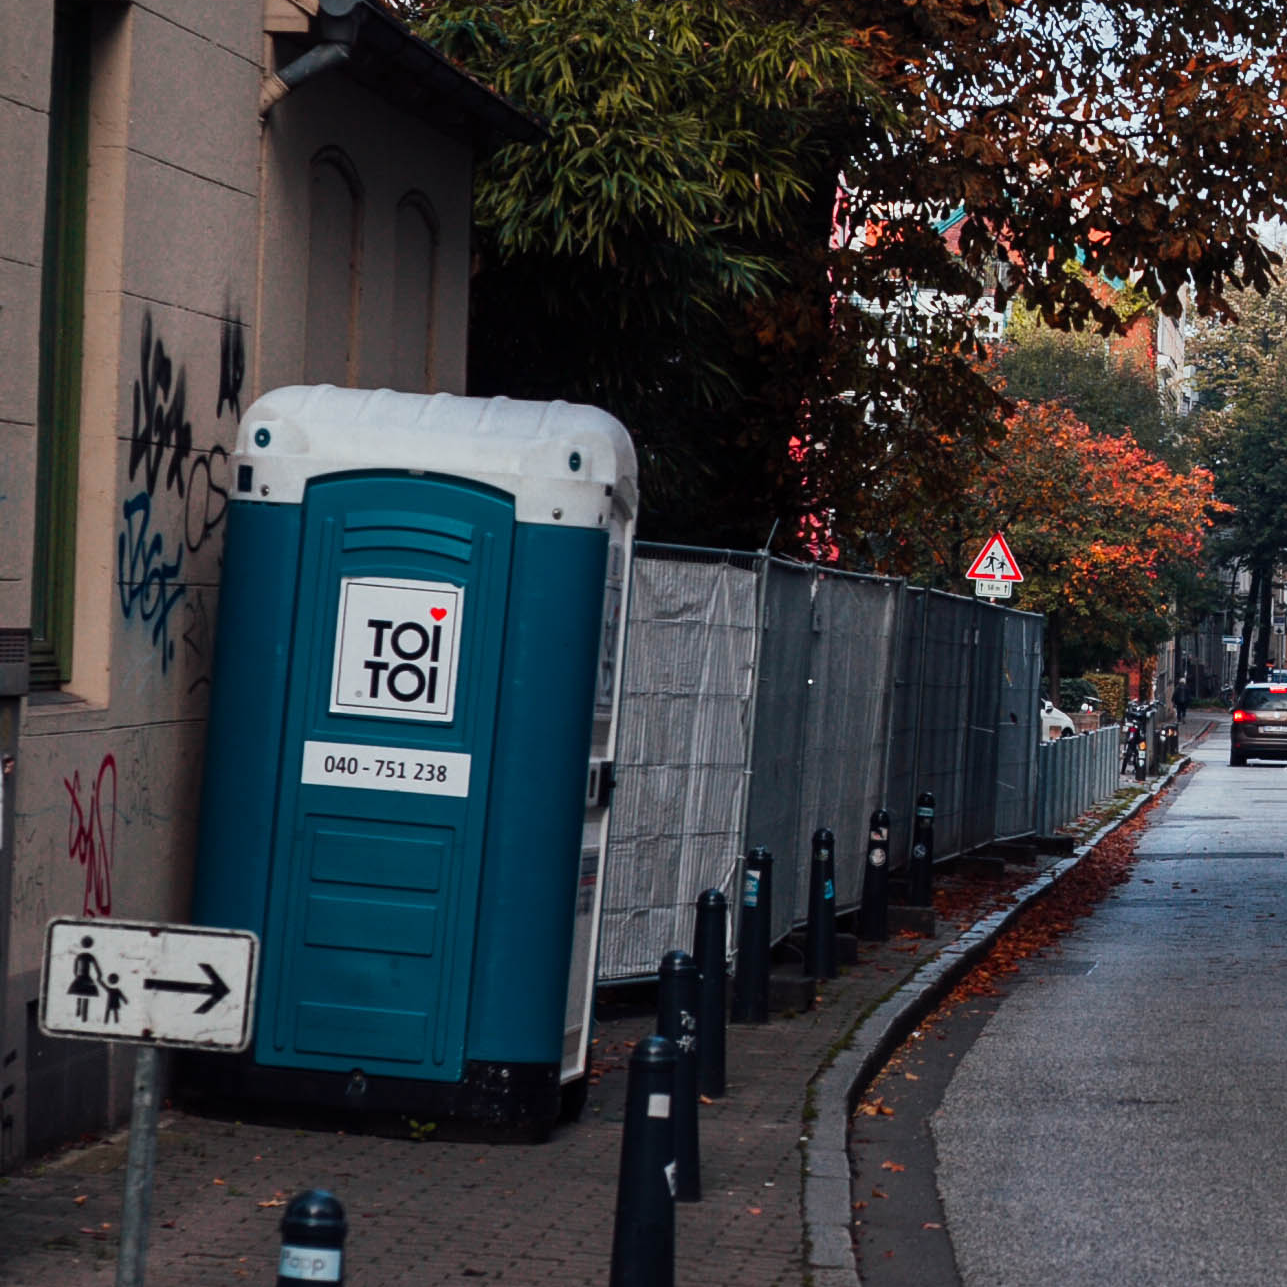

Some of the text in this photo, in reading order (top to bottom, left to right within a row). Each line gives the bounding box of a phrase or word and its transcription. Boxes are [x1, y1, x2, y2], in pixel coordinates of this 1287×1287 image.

[368, 619, 442, 662] TOI
[364, 660, 438, 703] TOI
[324, 755, 358, 775] 040
[375, 760, 406, 779] 751
[413, 763, 447, 782] 238
